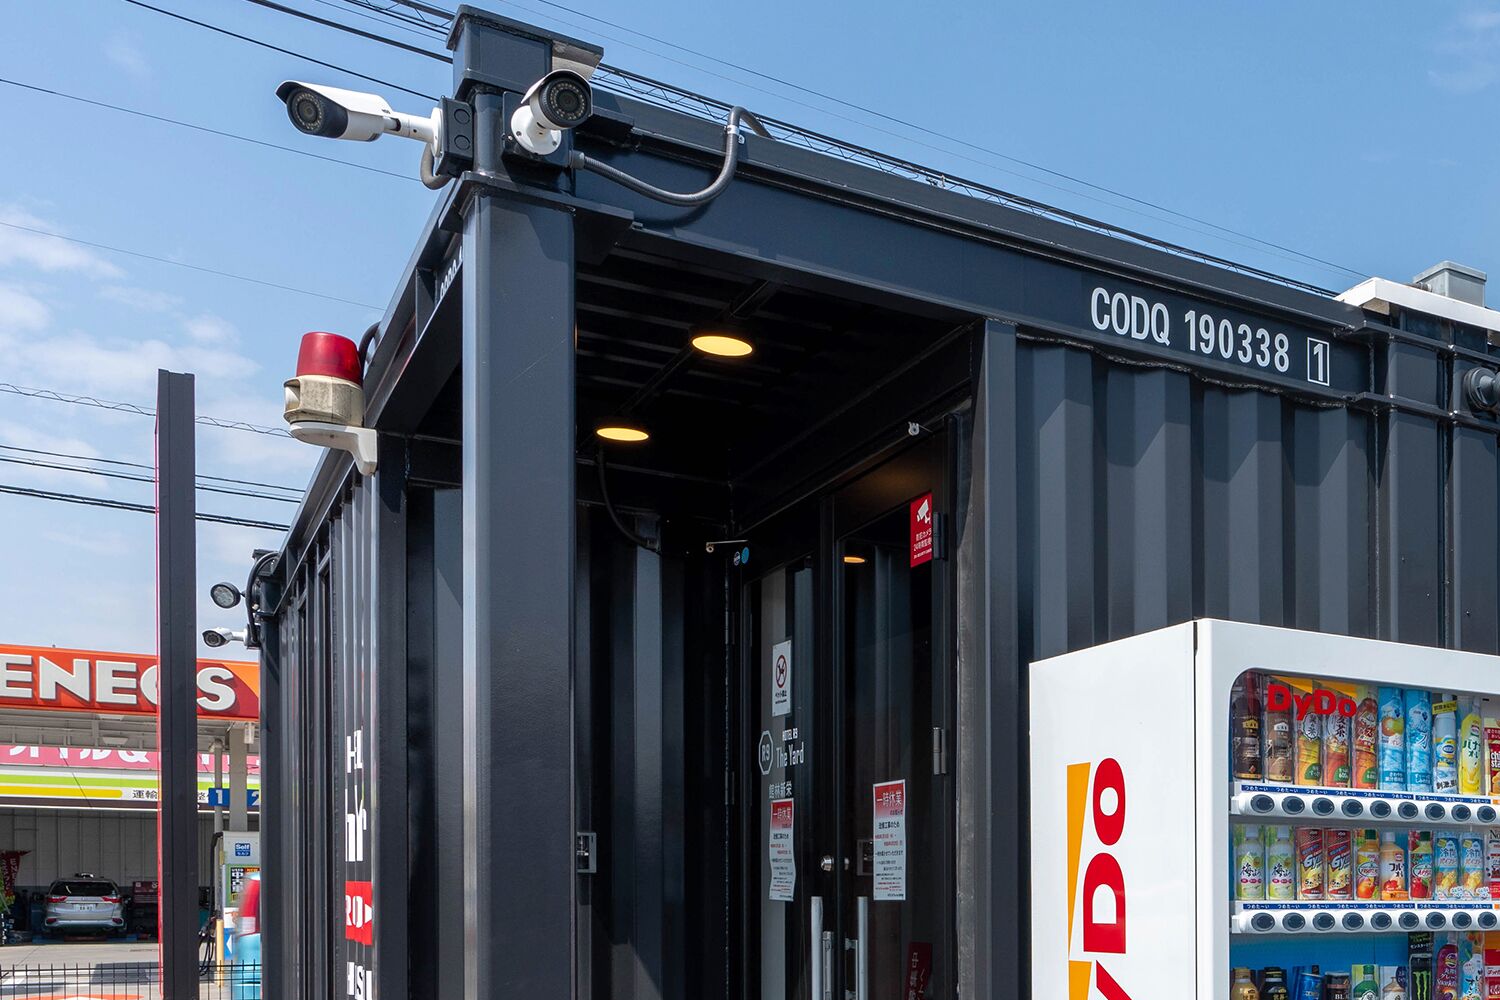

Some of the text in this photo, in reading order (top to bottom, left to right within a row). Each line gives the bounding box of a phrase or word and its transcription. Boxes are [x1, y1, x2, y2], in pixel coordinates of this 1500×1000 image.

[1091, 287, 1324, 382] CODQ 190338 1
[1266, 684, 1357, 721] DyDo
[776, 741, 805, 769] The Yard
[215, 789, 224, 804] 1
[236, 843, 250, 851] Self
